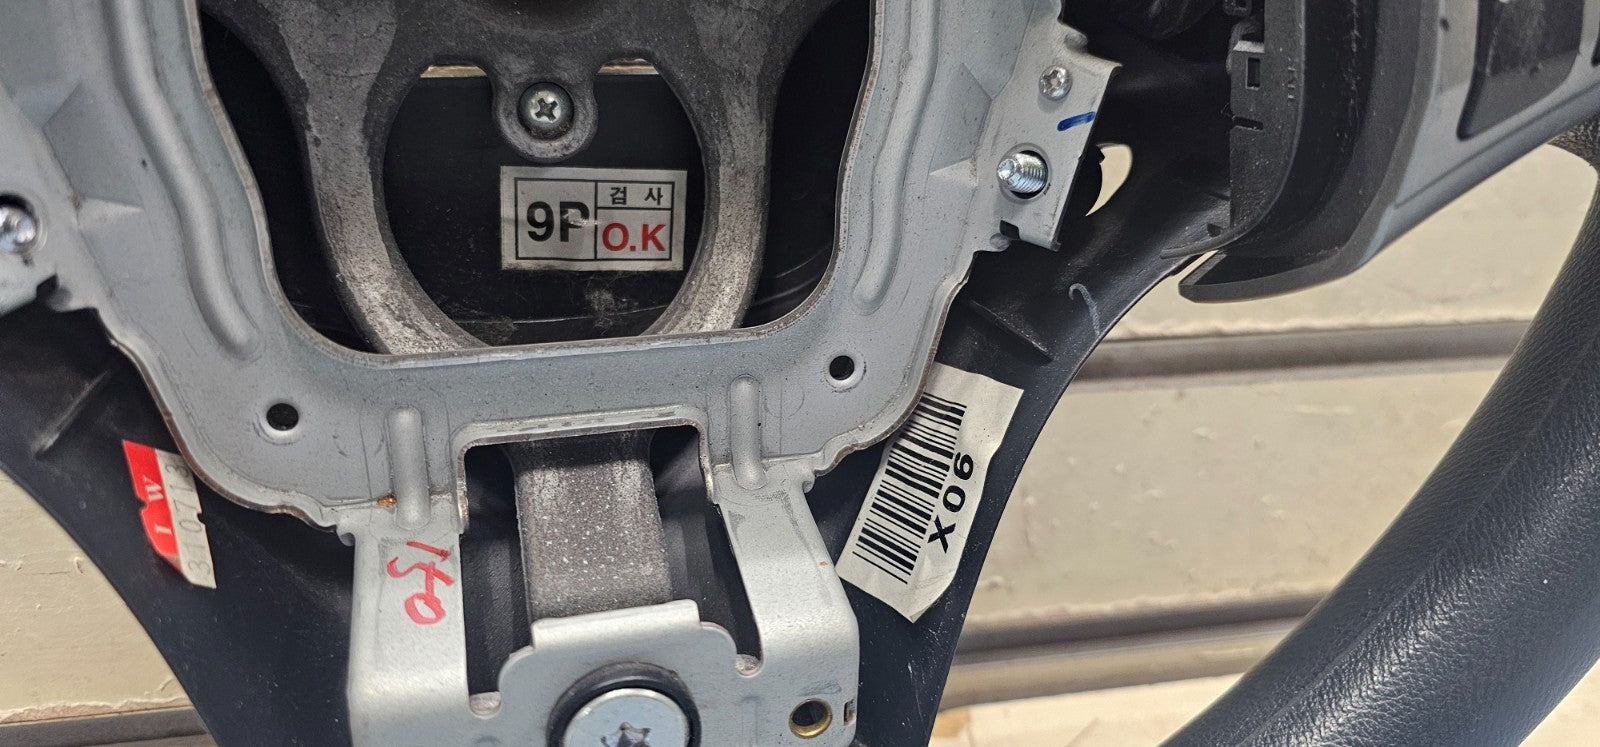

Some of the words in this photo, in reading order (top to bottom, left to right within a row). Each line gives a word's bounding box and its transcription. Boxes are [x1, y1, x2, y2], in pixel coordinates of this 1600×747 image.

[610, 186, 627, 205] 검
[644, 187, 663, 205] 사
[526, 201, 590, 243] 9P
[602, 222, 666, 252] O.K
[927, 451, 974, 554] X06
